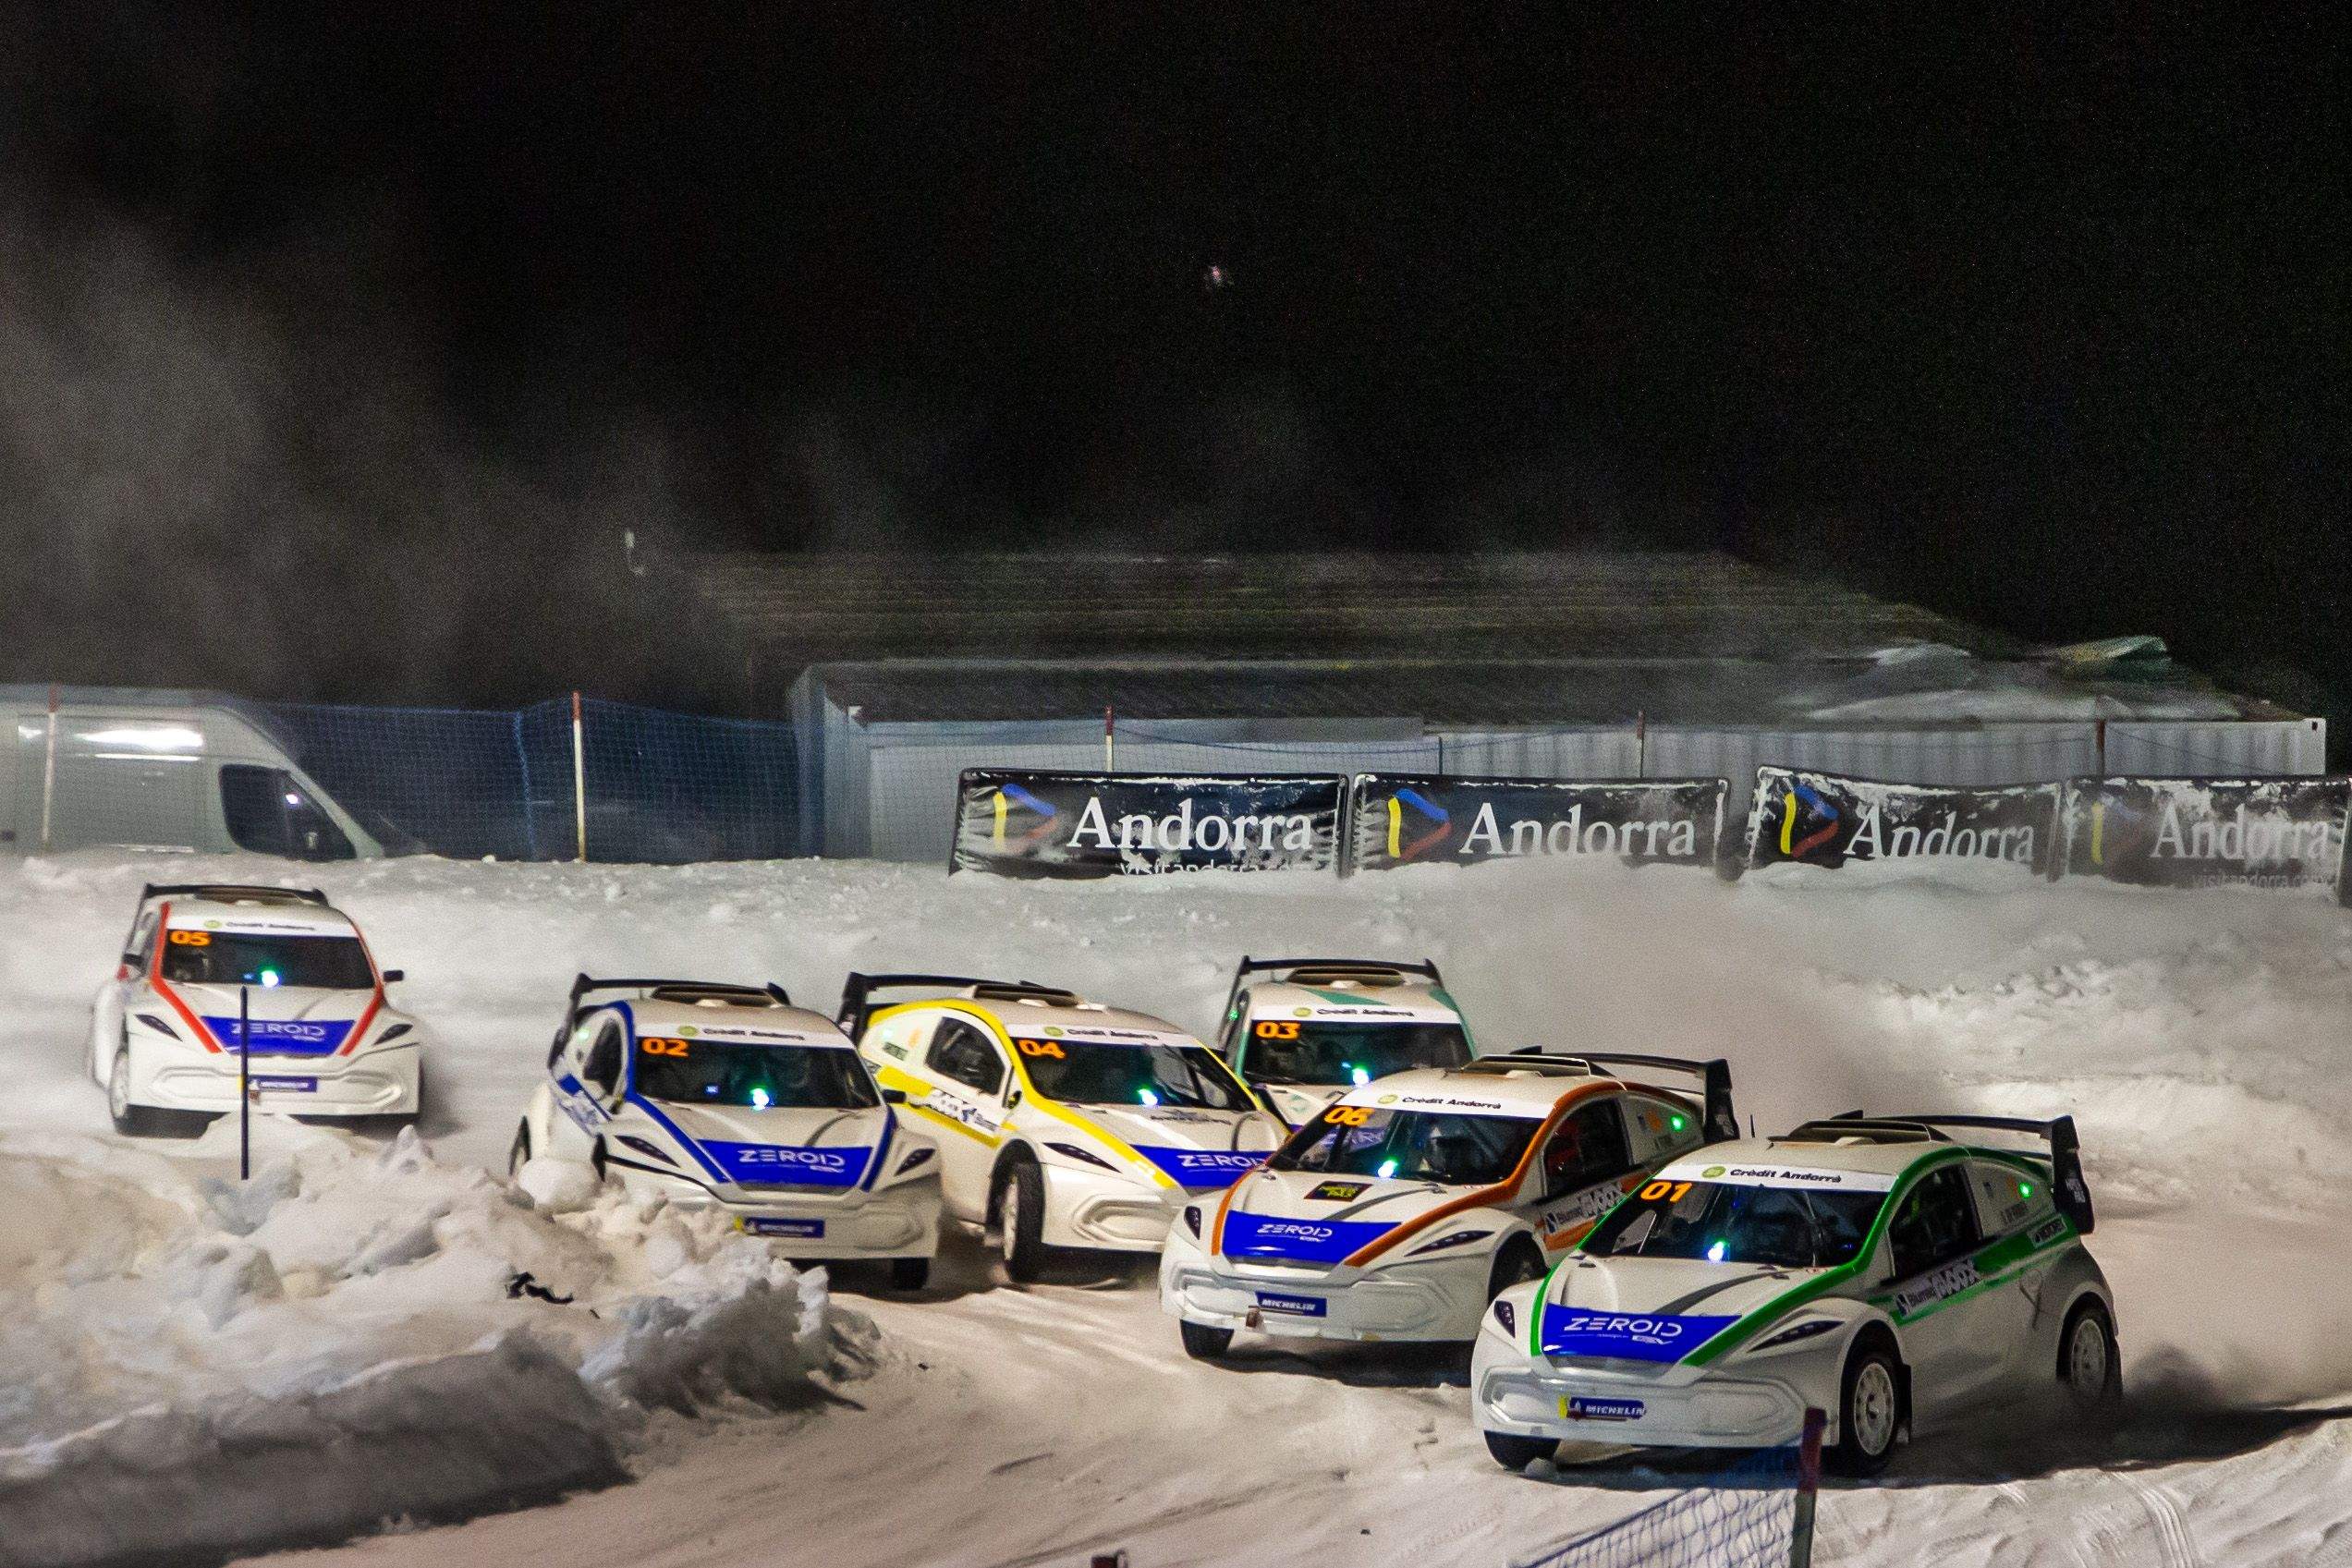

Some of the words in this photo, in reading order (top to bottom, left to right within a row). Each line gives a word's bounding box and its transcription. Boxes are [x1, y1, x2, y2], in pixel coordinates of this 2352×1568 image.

[1066, 796, 1312, 851] Andorra
[1458, 802, 1696, 857] Andorra
[1843, 802, 2034, 860] Andorra
[2150, 803, 2329, 860] Andorra
[170, 930, 212, 946] 05
[1255, 1021, 1301, 1039] 03
[642, 1037, 689, 1057] 02
[1018, 1039, 1066, 1059] 04
[1323, 1106, 1375, 1126] 06
[737, 1149, 847, 1166] ZEROID
[1176, 1154, 1268, 1168] ZEROI
[1639, 1181, 1693, 1203] 01
[1257, 1223, 1334, 1237] ZEROID
[1564, 1317, 1683, 1337] ZEROID
[1585, 1404, 1645, 1416] MICHELIN
